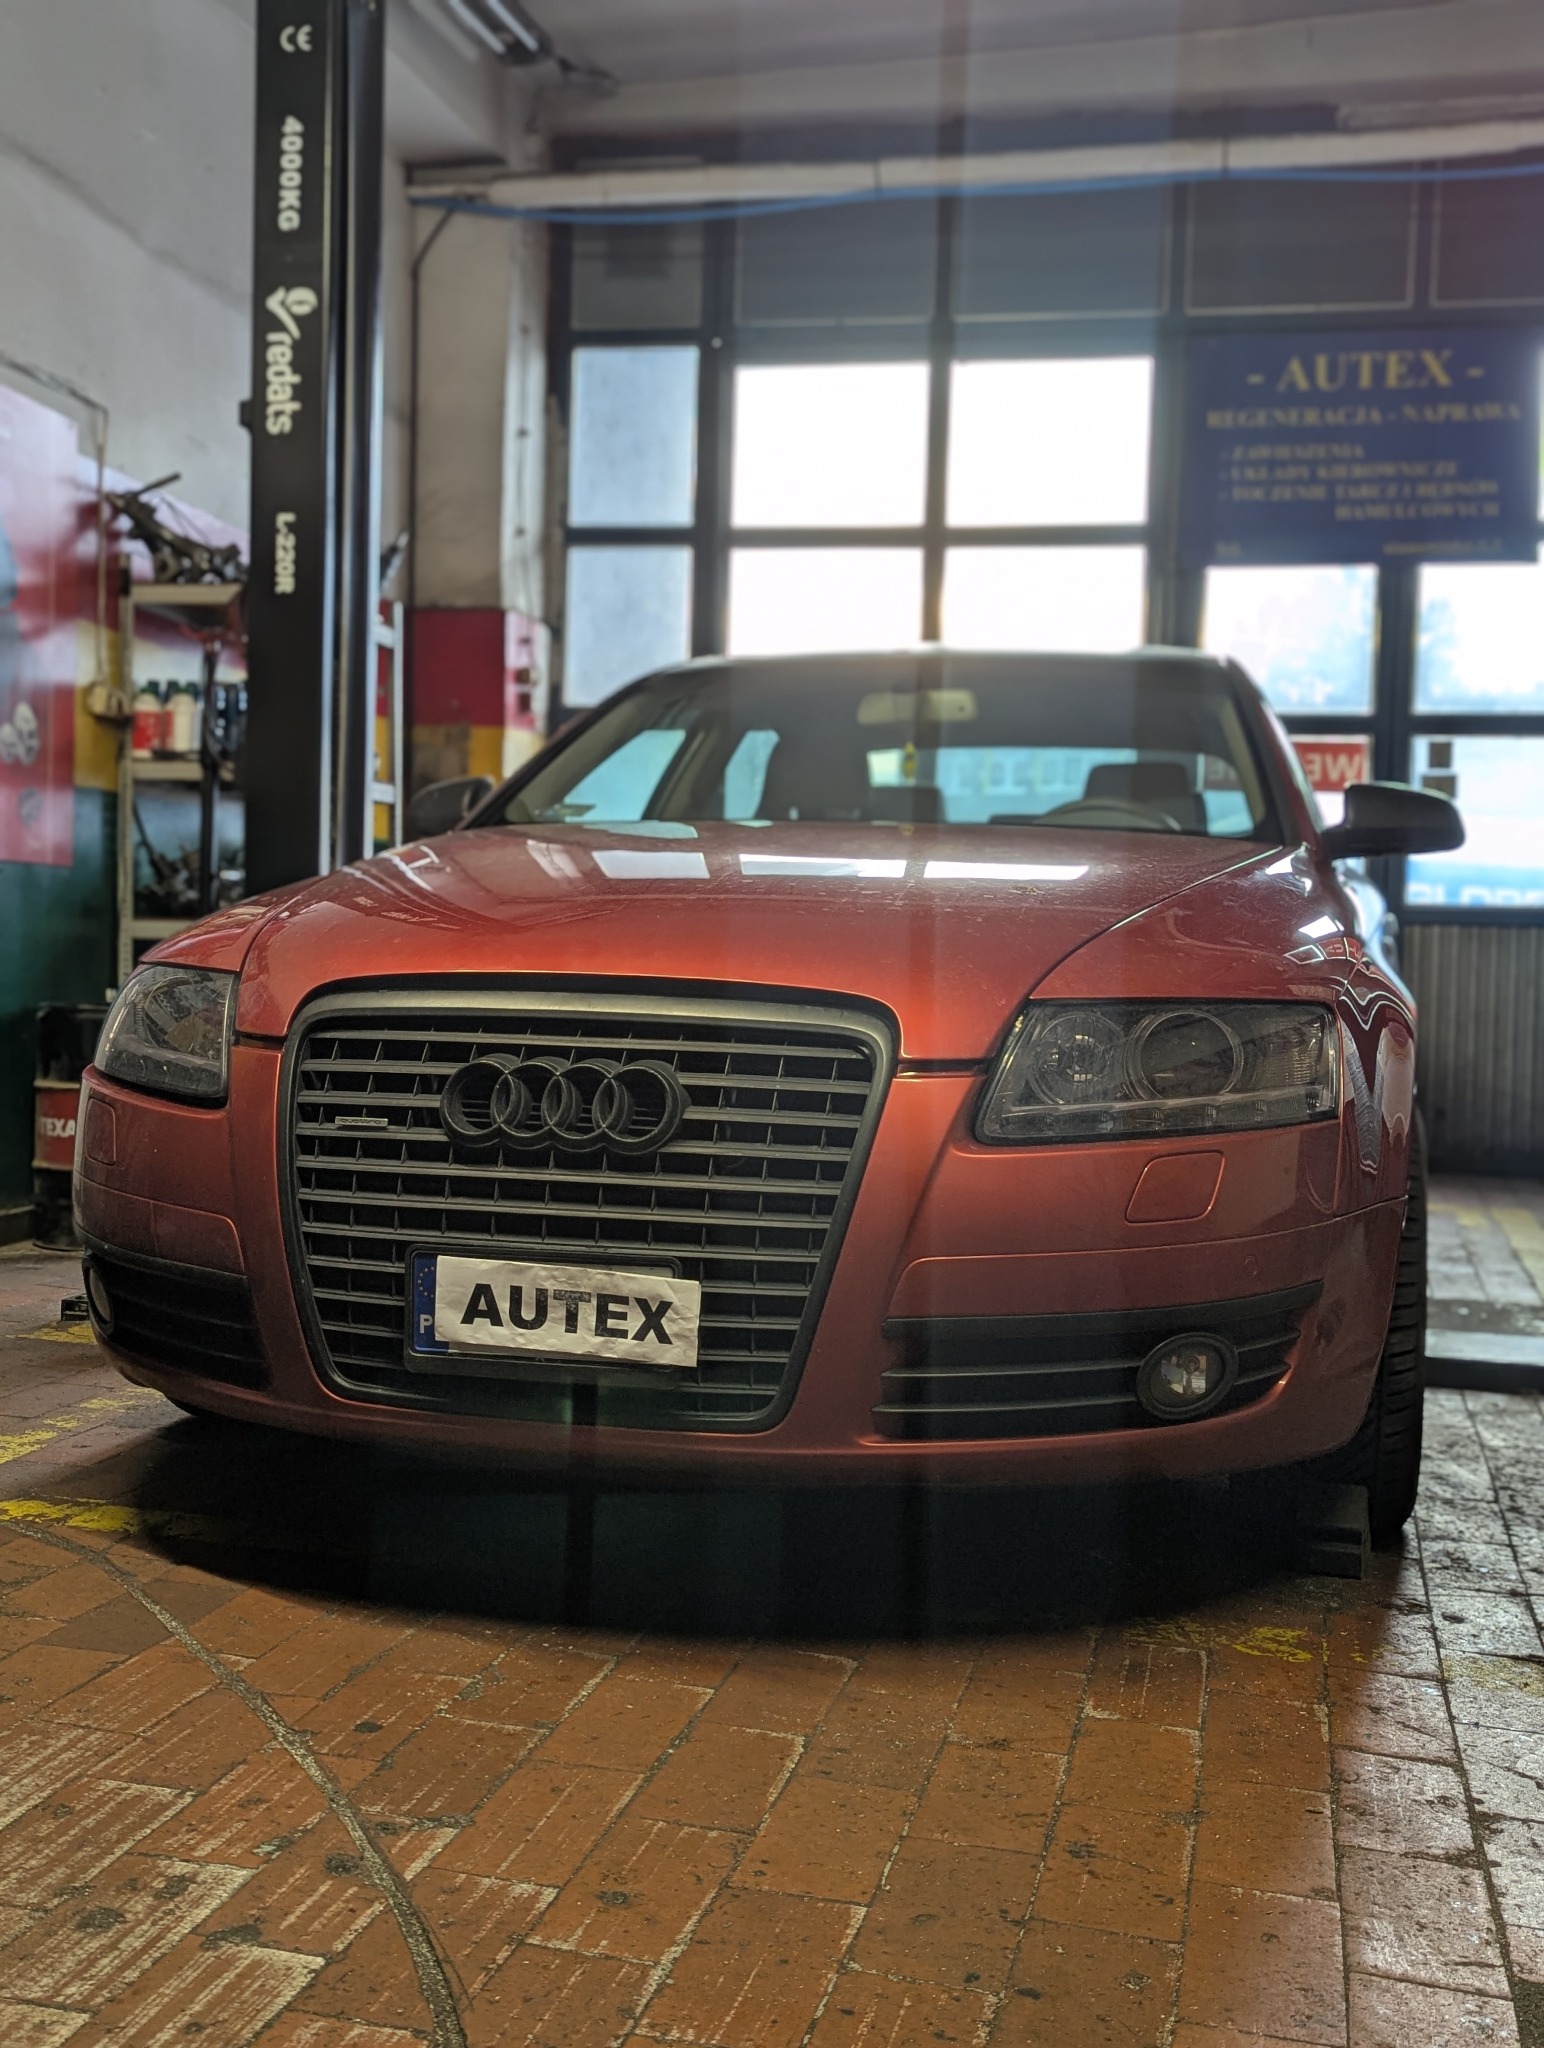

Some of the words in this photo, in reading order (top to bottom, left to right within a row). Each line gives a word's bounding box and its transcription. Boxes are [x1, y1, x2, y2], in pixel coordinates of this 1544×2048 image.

[278, 115, 305, 232] 4000KG
[265, 332, 302, 436] redats
[1277, 348, 1454, 392] AUTEX
[1206, 406, 1382, 429] REGENERACJA
[1401, 402, 1521, 425] NAPRAWA
[275, 512, 296, 596] L-220R
[339, 1117, 382, 1126] quattro
[460, 1282, 674, 1345] AUTEX
